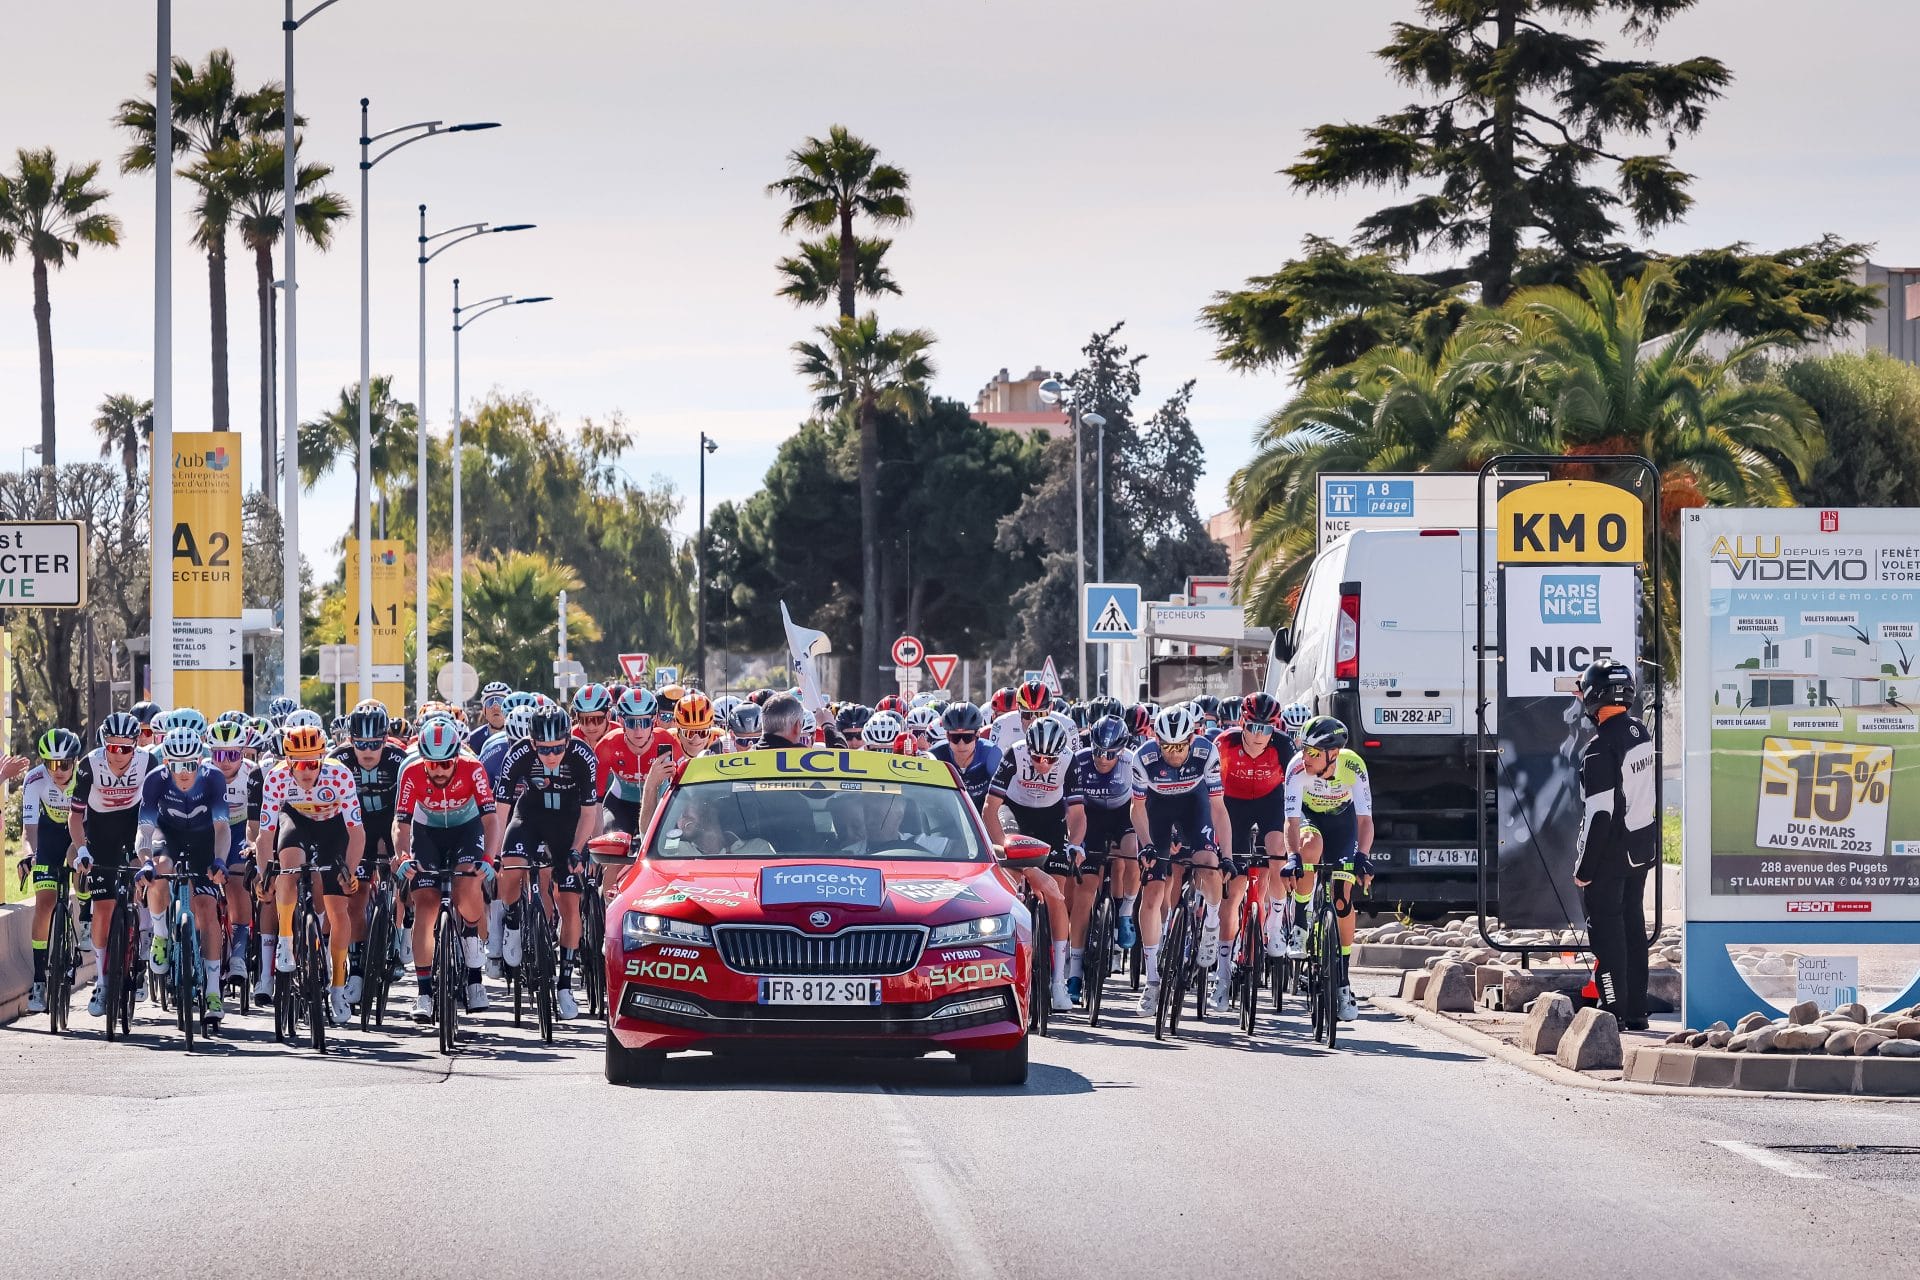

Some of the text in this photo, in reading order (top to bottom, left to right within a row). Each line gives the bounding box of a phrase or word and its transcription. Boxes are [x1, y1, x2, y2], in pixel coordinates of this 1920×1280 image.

[1366, 483, 1390, 496] A 8
[1371, 499, 1408, 513] péage
[1689, 514, 1700, 522] 38
[1325, 521, 1351, 531] NICE
[1513, 513, 1585, 552] KM
[1711, 535, 1781, 572] ALU
[1783, 548, 1863, 556] DEPUIS 1978
[172, 571, 230, 582] ECTEUR
[1711, 559, 1868, 581] VIDEMO
[1543, 584, 1597, 598] PARIS
[1737, 591, 1913, 602] www.aluvidemo.com
[1543, 598, 1597, 616] NICE
[1157, 610, 1206, 620] PECHEURS
[173, 643, 206, 651] ETALLOS
[173, 659, 200, 667] ETIERS
[719, 757, 757, 768] LCL
[776, 750, 867, 774] LCL
[892, 758, 929, 772] LCL
[100, 773, 138, 788] UAE
[1022, 766, 1058, 785] UAE
[759, 781, 807, 789] OFFICIEL
[1788, 823, 1855, 838] DU 6 MARS
[1769, 834, 1872, 852] AU 9 AVRIL 2023
[1761, 862, 1888, 875] 288 avenue des Pugets
[1730, 877, 1920, 887] ST LAURENT DU VAR 04 93 07 77 33
[816, 883, 867, 899] sport
[659, 946, 700, 960] HYBRID
[941, 949, 981, 962] HYBRID
[1601, 971, 1617, 1005] YAMAHA
